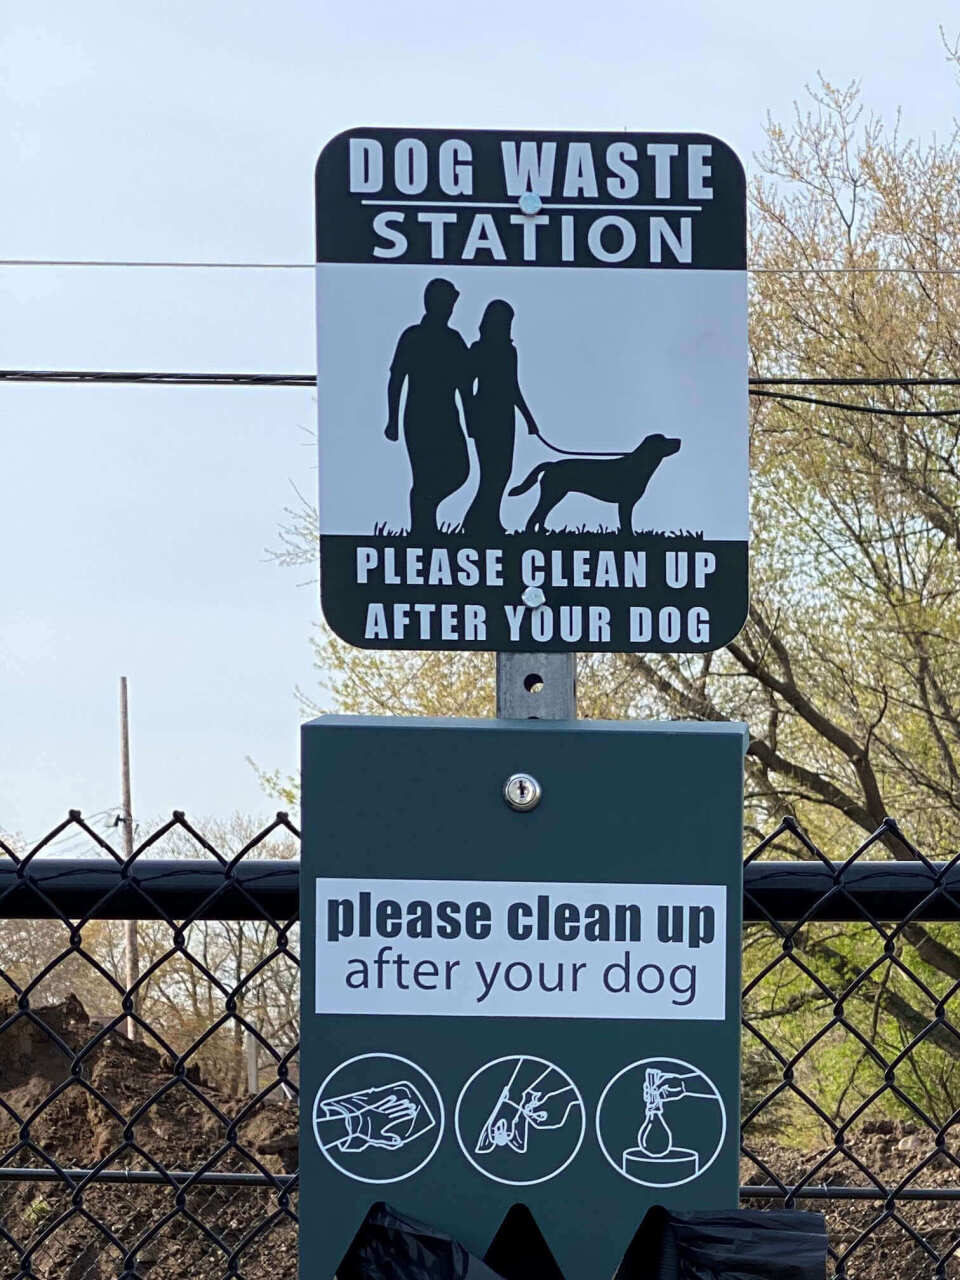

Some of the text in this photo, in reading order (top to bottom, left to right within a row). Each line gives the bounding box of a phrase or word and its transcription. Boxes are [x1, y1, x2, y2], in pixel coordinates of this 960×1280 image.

[349, 137, 714, 200] DOG WASTE
[372, 211, 693, 264] STATION
[356, 547, 716, 589] PLEASE CLEAN UP
[364, 603, 710, 643] AFTER YOUR DOG
[327, 891, 716, 948] please clean up
[346, 946, 696, 1006] after your dog
